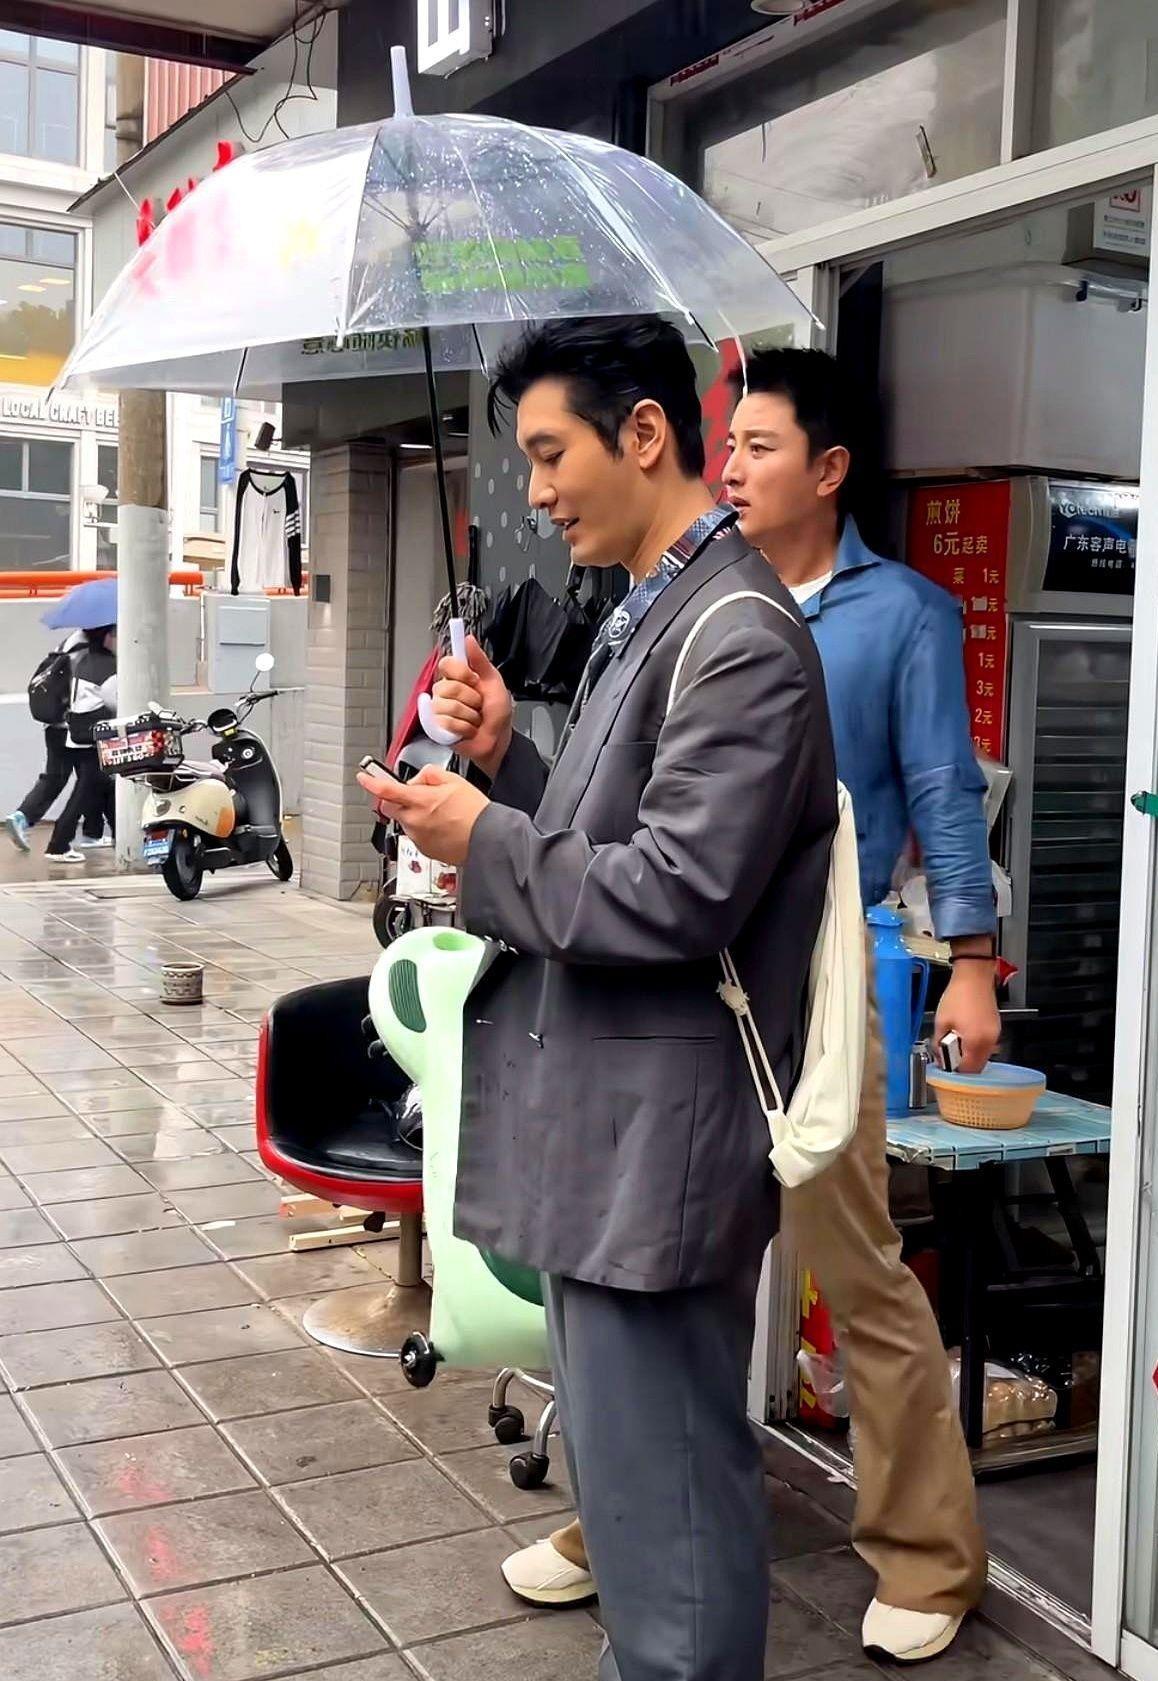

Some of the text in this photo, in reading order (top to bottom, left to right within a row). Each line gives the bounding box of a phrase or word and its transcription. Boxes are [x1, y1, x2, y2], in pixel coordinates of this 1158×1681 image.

[2, 397, 45, 420] LOCAL
[926, 498, 961, 526] 煎饼
[933, 532, 988, 556] 6元起卖
[982, 568, 999, 584] 1元
[978, 652, 995, 668] 1元
[976, 680, 994, 697] 3元
[974, 708, 992, 725] 2元
